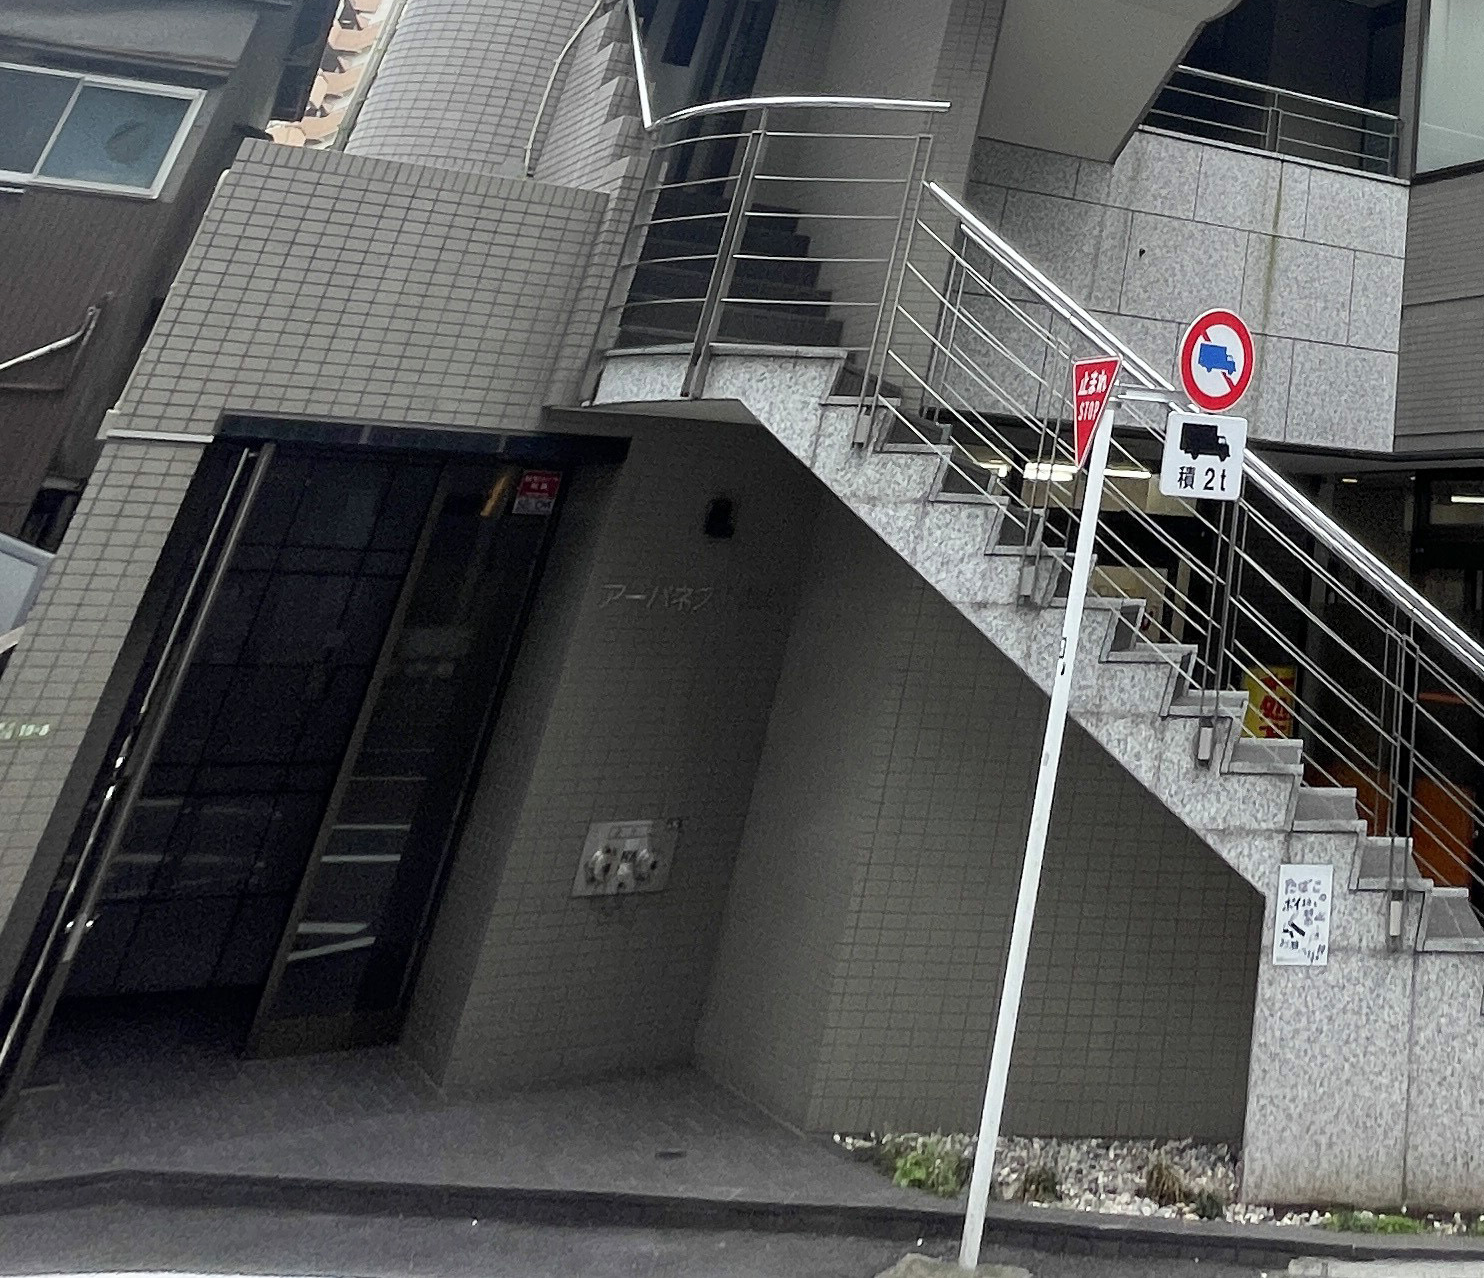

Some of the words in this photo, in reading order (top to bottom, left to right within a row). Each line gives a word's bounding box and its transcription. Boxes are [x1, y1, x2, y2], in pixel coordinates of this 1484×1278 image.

[1077, 370, 1108, 397] 止まれ
[1077, 401, 1100, 421] STOP
